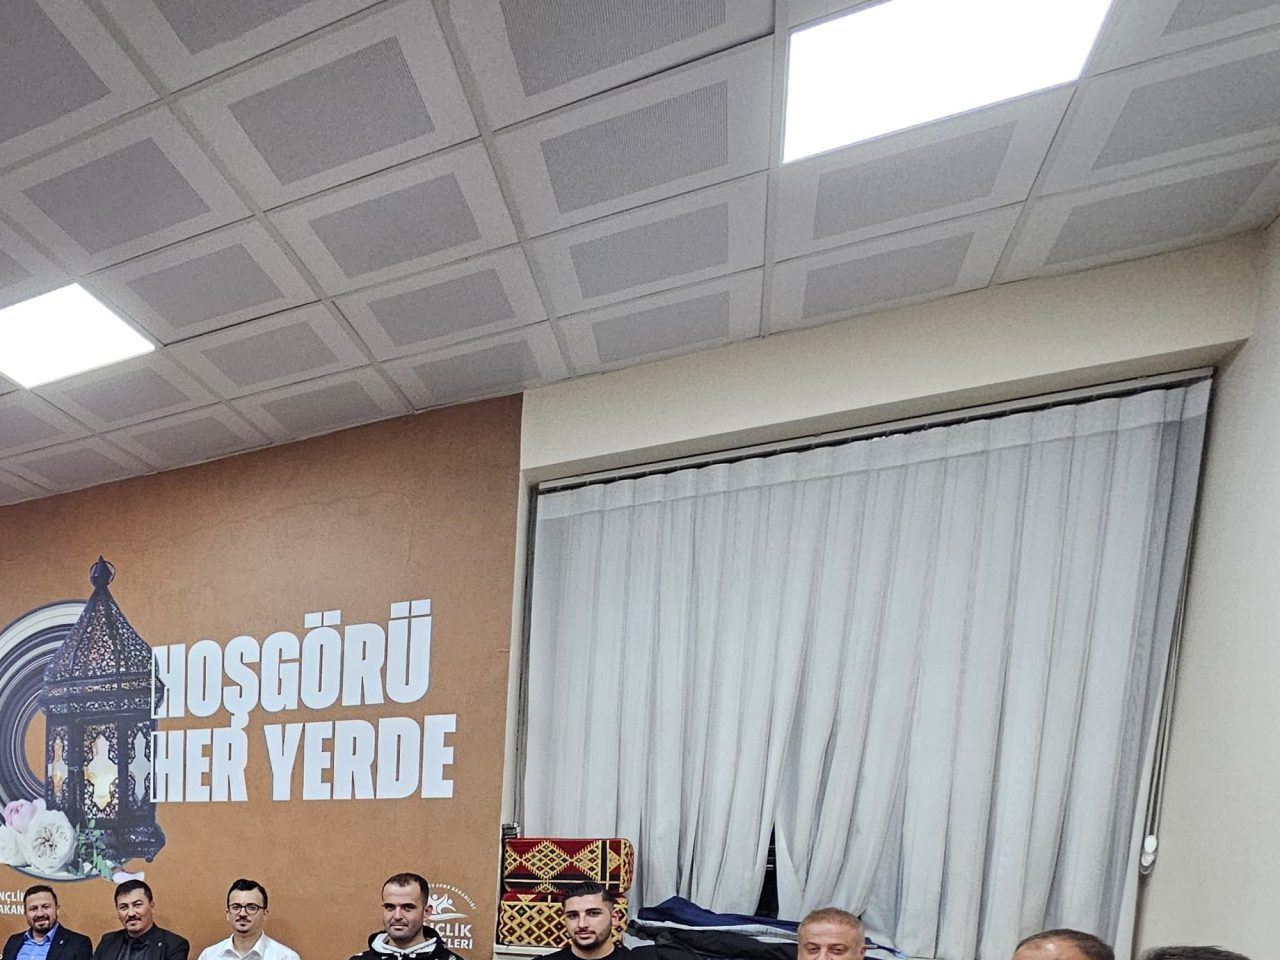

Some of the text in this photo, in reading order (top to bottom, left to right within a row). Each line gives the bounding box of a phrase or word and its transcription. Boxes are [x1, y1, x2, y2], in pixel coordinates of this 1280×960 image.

[151, 598, 432, 728] HOŞGÖRÜ
[150, 713, 457, 803] HER YERDE
